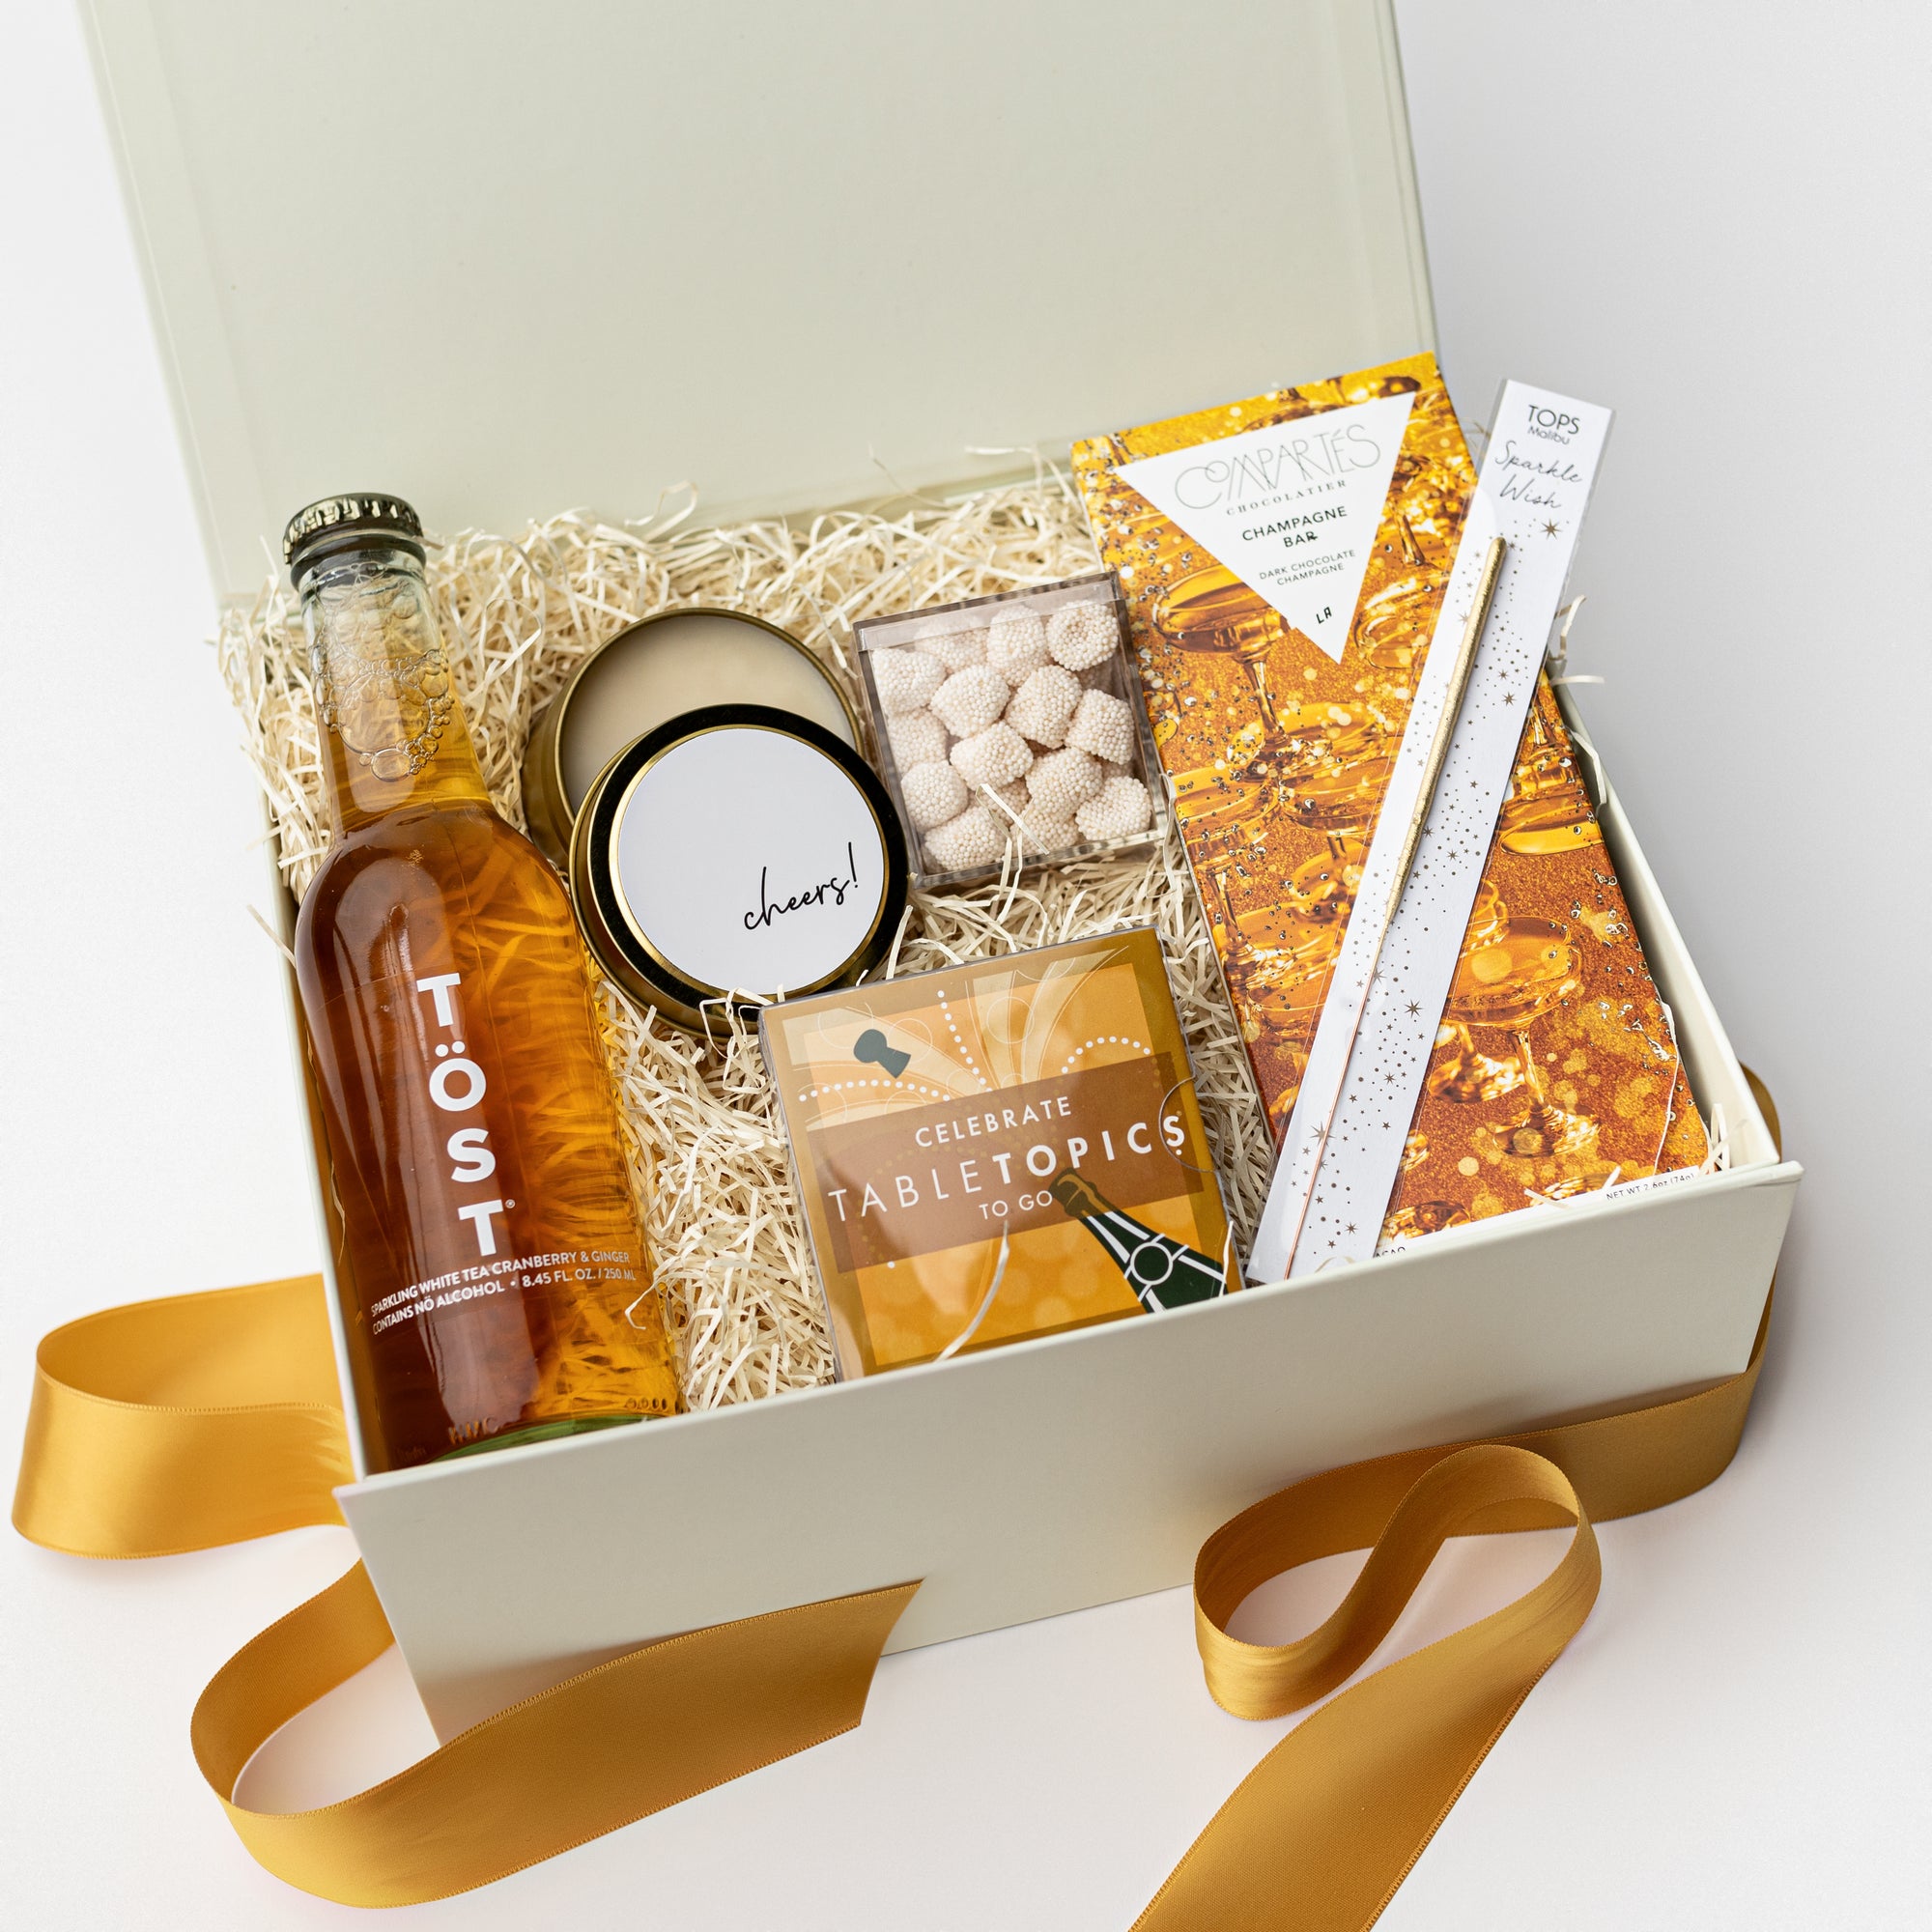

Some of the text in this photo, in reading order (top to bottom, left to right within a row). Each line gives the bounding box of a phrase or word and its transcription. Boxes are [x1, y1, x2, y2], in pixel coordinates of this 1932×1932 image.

[1527, 425, 1571, 445] Malibu
[1528, 404, 1580, 435] TOPS
[1175, 423, 1381, 510] COMPARTÉS
[1494, 440, 1583, 483] Sparkle
[1226, 479, 1348, 517] CHOCOLATIER
[1499, 473, 1562, 509] Wish
[1241, 505, 1349, 541] CHAMPAGNE
[1283, 530, 1319, 548] BAR
[1259, 549, 1356, 580] DARK CHOCOLATE
[1276, 562, 1346, 586] CHAMPAGNE
[1315, 606, 1333, 624] LA
[744, 841, 859, 930] cheers!
[915, 1095, 1071, 1149] CELEBRATE
[828, 1115, 1186, 1223] TABLETOPICS
[979, 1189, 1054, 1221] TO GO
[1605, 1189, 1625, 1201] NET
[1626, 1184, 1642, 1196] WT
[370, 1250, 631, 1318] SPARKLING WHITE TEA CRANBERRY & GINGER
[372, 1304, 414, 1336] CONTAINS
[414, 1294, 435, 1315] NÖ
[436, 1279, 506, 1308] ALCOHOL
[522, 1270, 553, 1289] 8.45
[553, 1269, 573, 1284] FL.
[575, 1267, 596, 1280] OZ.
[604, 1266, 622, 1280] 250
[623, 1267, 638, 1281] ML
